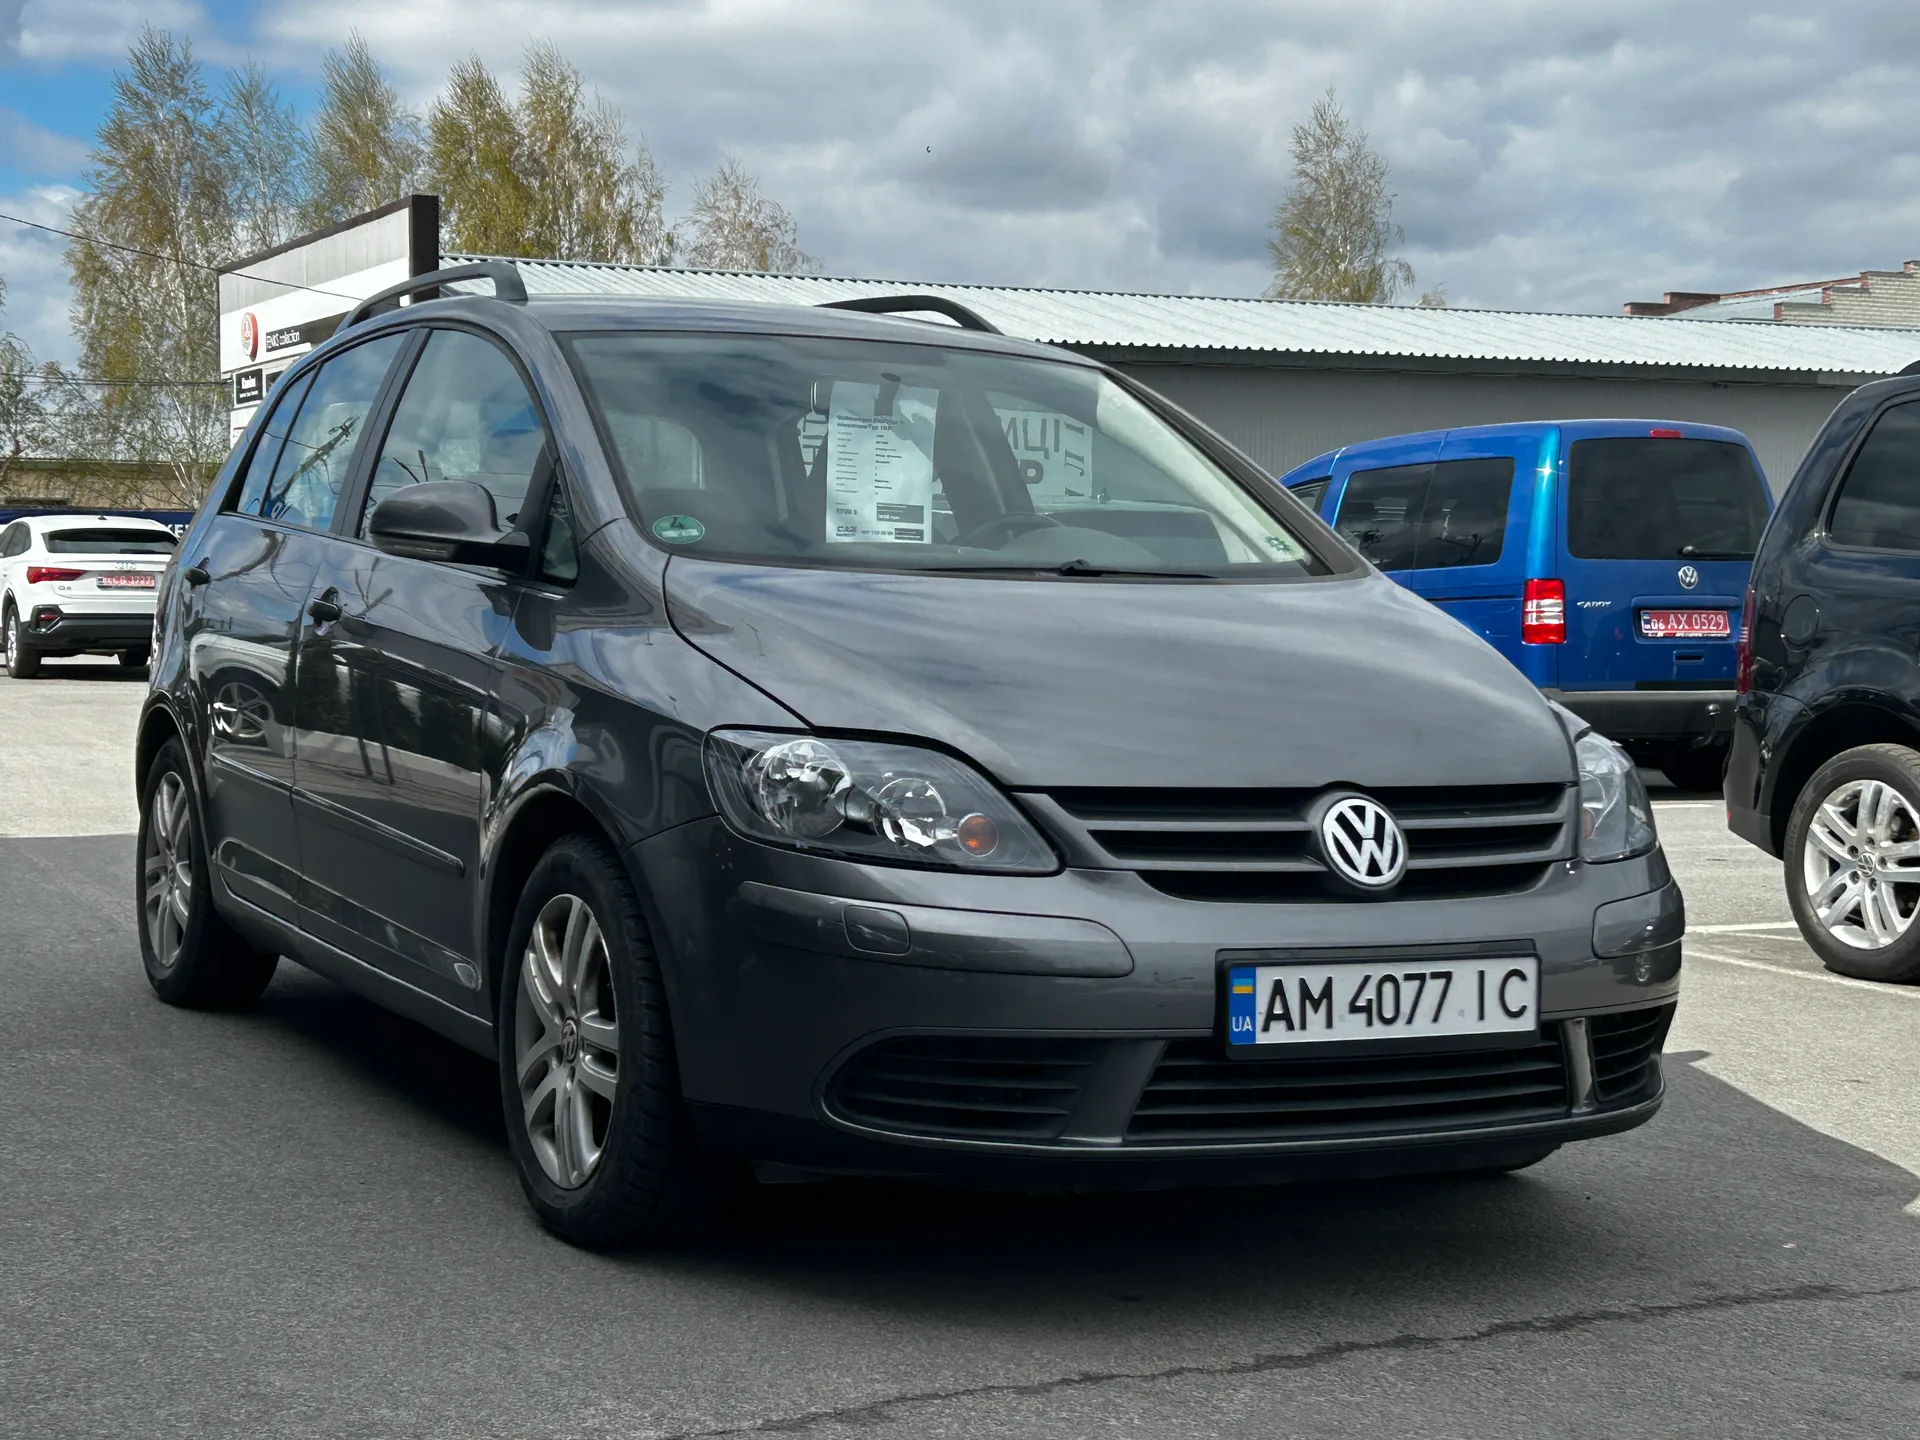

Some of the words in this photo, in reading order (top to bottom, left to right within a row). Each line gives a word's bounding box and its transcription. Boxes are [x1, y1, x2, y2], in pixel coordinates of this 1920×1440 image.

[1576, 600, 1612, 608] CADDY
[1668, 613, 1690, 630] AX
[1692, 614, 1725, 630] 0529
[1261, 976, 1334, 1032] AM
[1348, 970, 1453, 1028] 4077
[1476, 968, 1528, 1021] IC
[1232, 1015, 1253, 1032] UA
